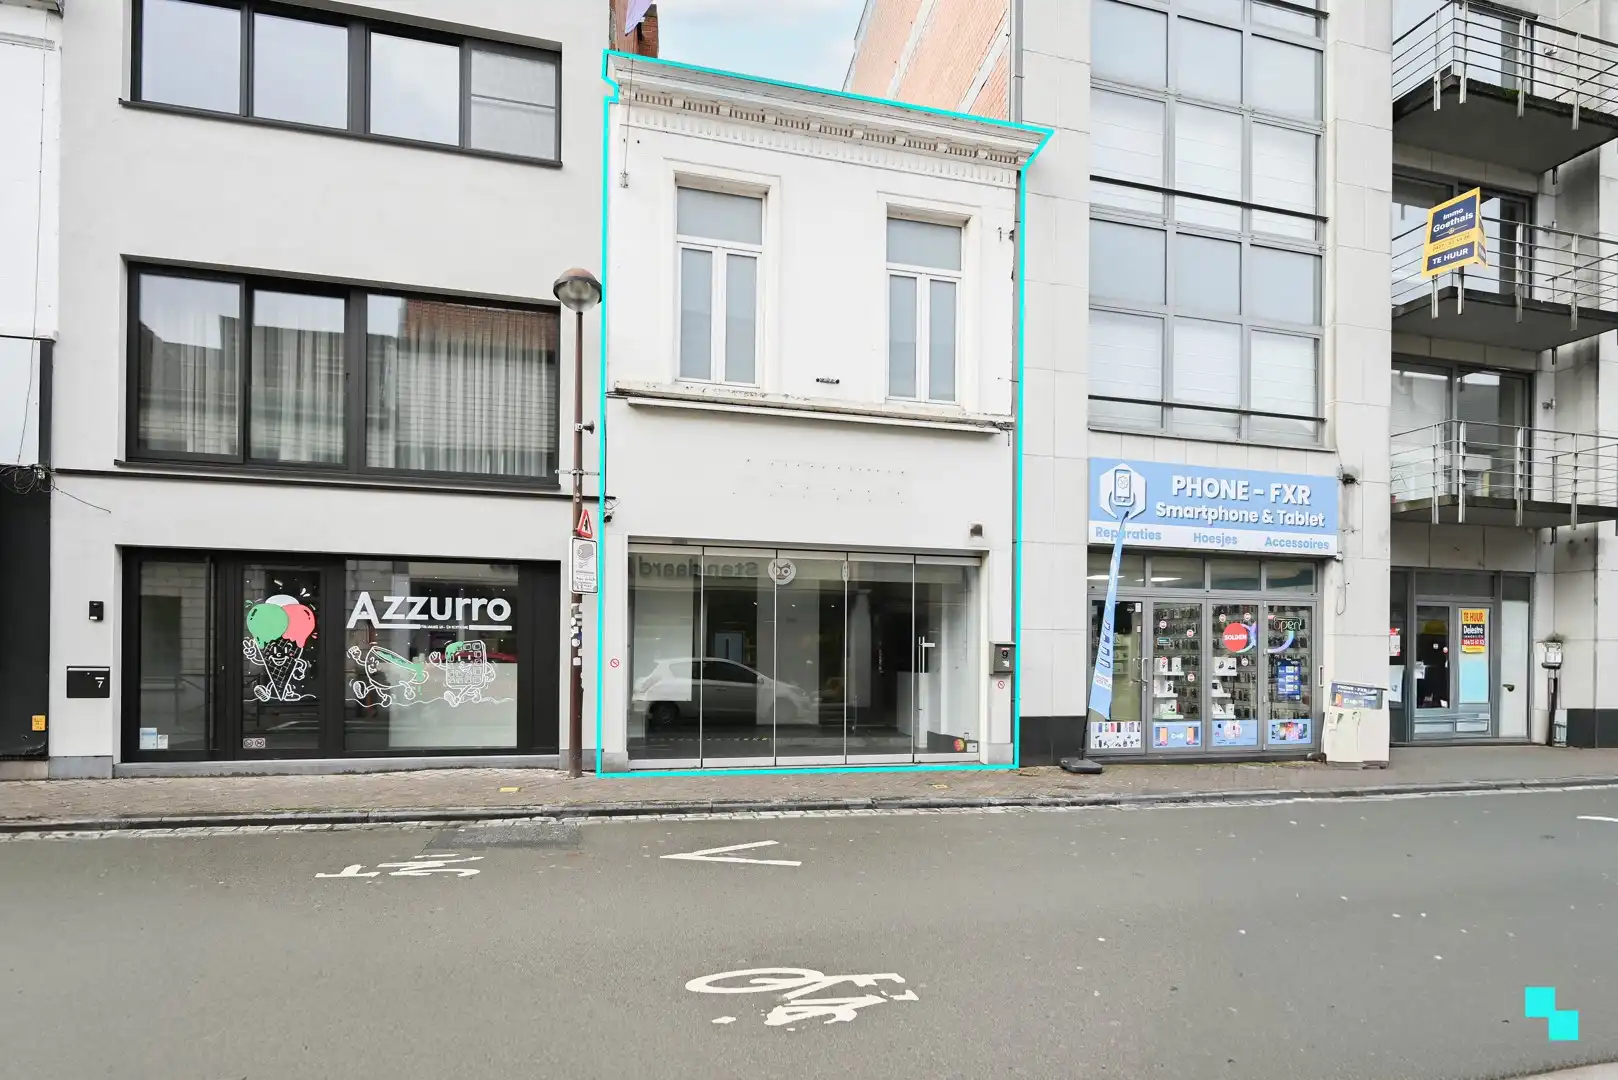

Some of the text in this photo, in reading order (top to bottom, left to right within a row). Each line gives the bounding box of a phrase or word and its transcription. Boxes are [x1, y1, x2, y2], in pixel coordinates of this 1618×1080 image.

[1433, 212, 1474, 232] Goethals
[1443, 208, 1464, 220] Immo
[1432, 255, 1442, 266] TE
[1443, 247, 1469, 262] HUUR
[1172, 475, 1250, 501] PHONE
[1270, 483, 1312, 505] FXR
[1155, 501, 1326, 527] Smartphone & Tablet
[1193, 532, 1238, 546] Hoesjes
[1264, 536, 1330, 550] Accessoires
[346, 591, 512, 629] Azzurro
[1273, 620, 1301, 633] open
[1002, 650, 1008, 659] 9
[97, 680, 103, 689] 7
